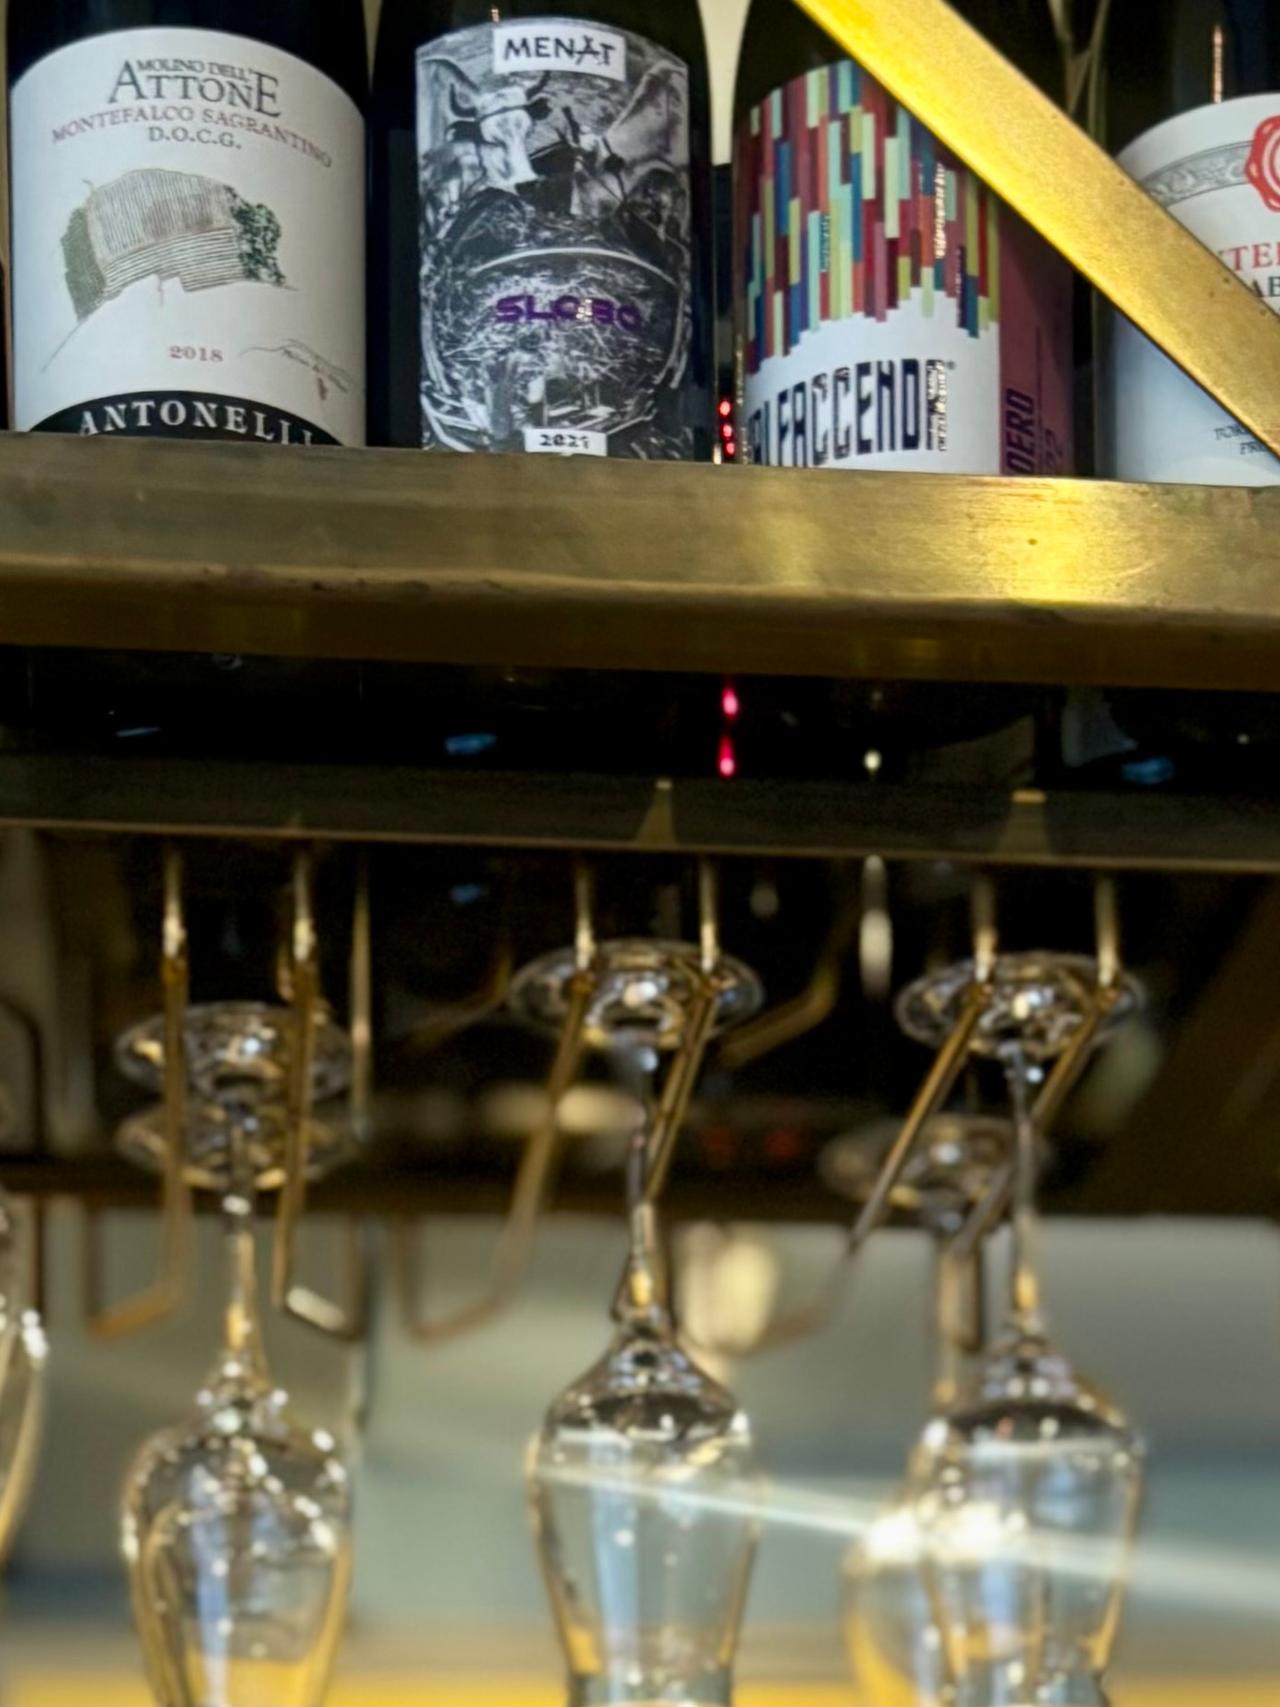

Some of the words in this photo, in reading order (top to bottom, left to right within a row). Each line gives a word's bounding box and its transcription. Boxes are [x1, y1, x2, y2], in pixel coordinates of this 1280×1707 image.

[107, 60, 281, 118] ATTONE
[51, 106, 195, 144] MONTEFALCO
[202, 108, 332, 169] SAGRANTINO
[148, 126, 243, 150] D.O.C.G.
[169, 346, 225, 362] 2018
